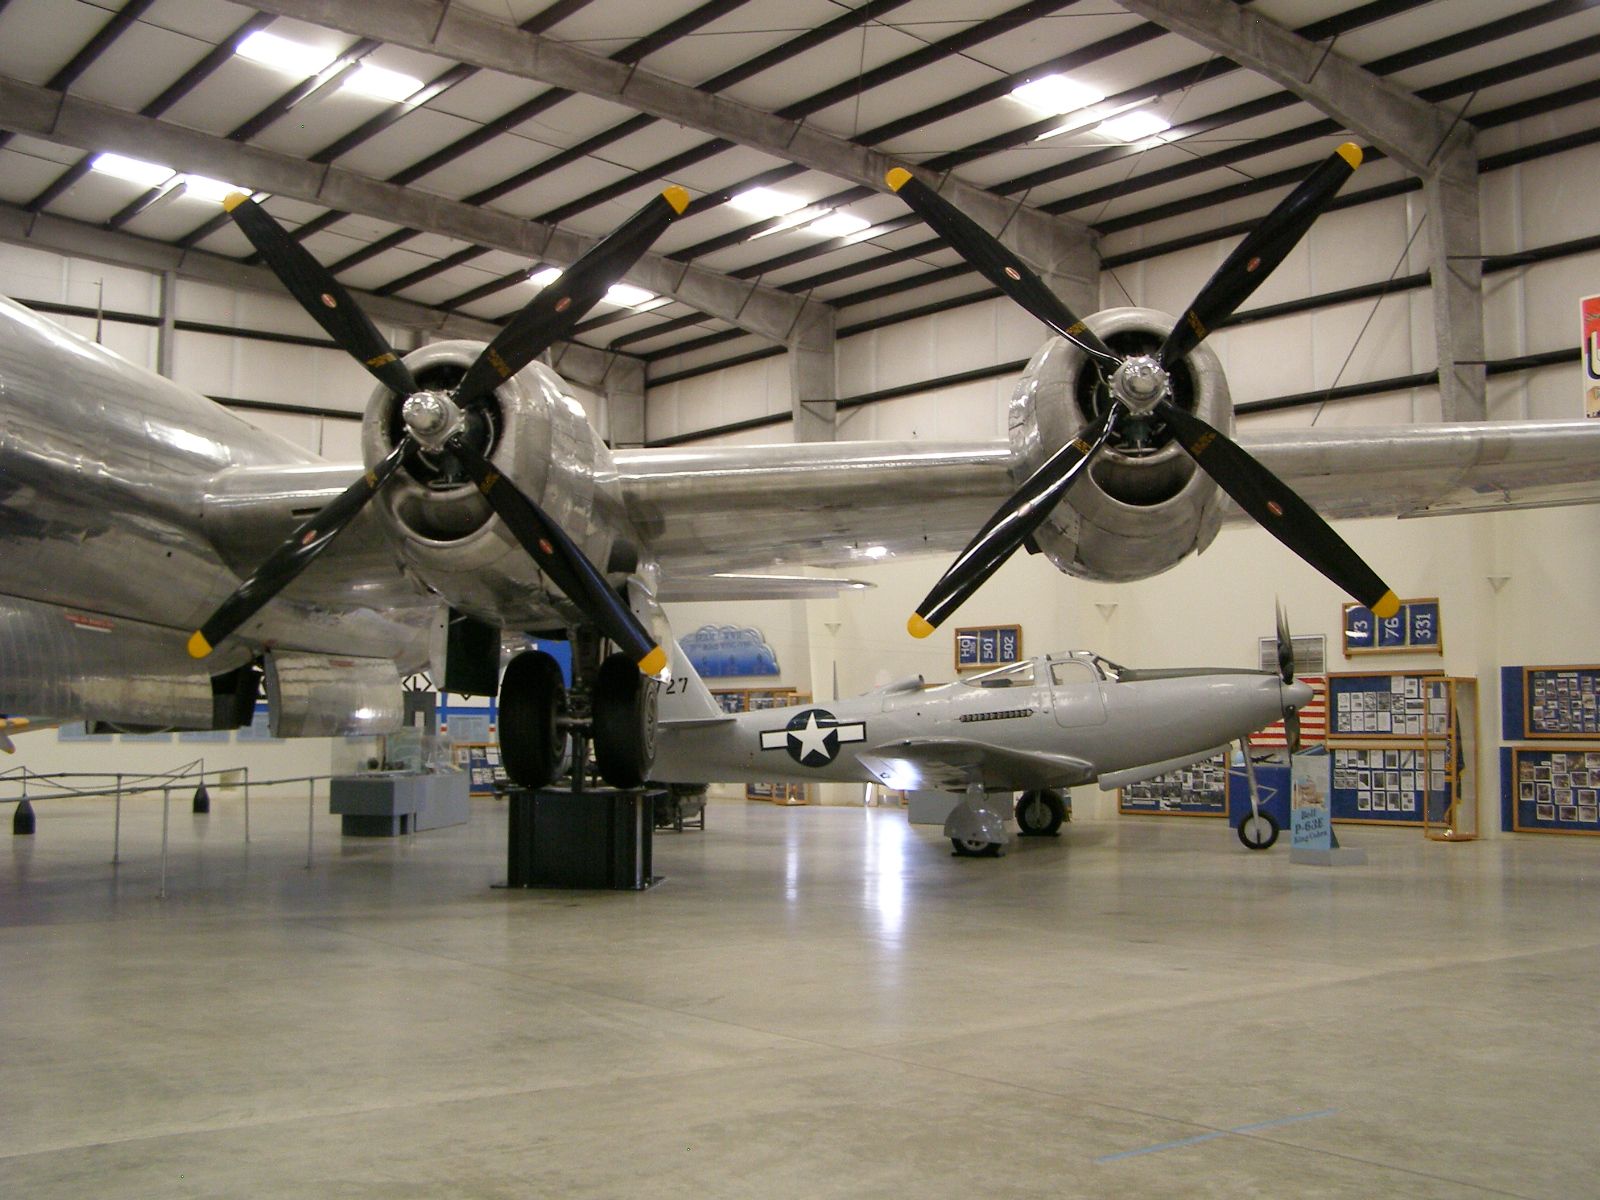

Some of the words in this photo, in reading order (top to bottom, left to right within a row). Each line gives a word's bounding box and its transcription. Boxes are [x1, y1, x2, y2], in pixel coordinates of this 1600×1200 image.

[1384, 617, 1400, 639] 76
[1415, 613, 1431, 639] 331
[961, 639, 971, 657] HQ
[983, 637, 994, 659] 501
[1003, 635, 1015, 659] 502
